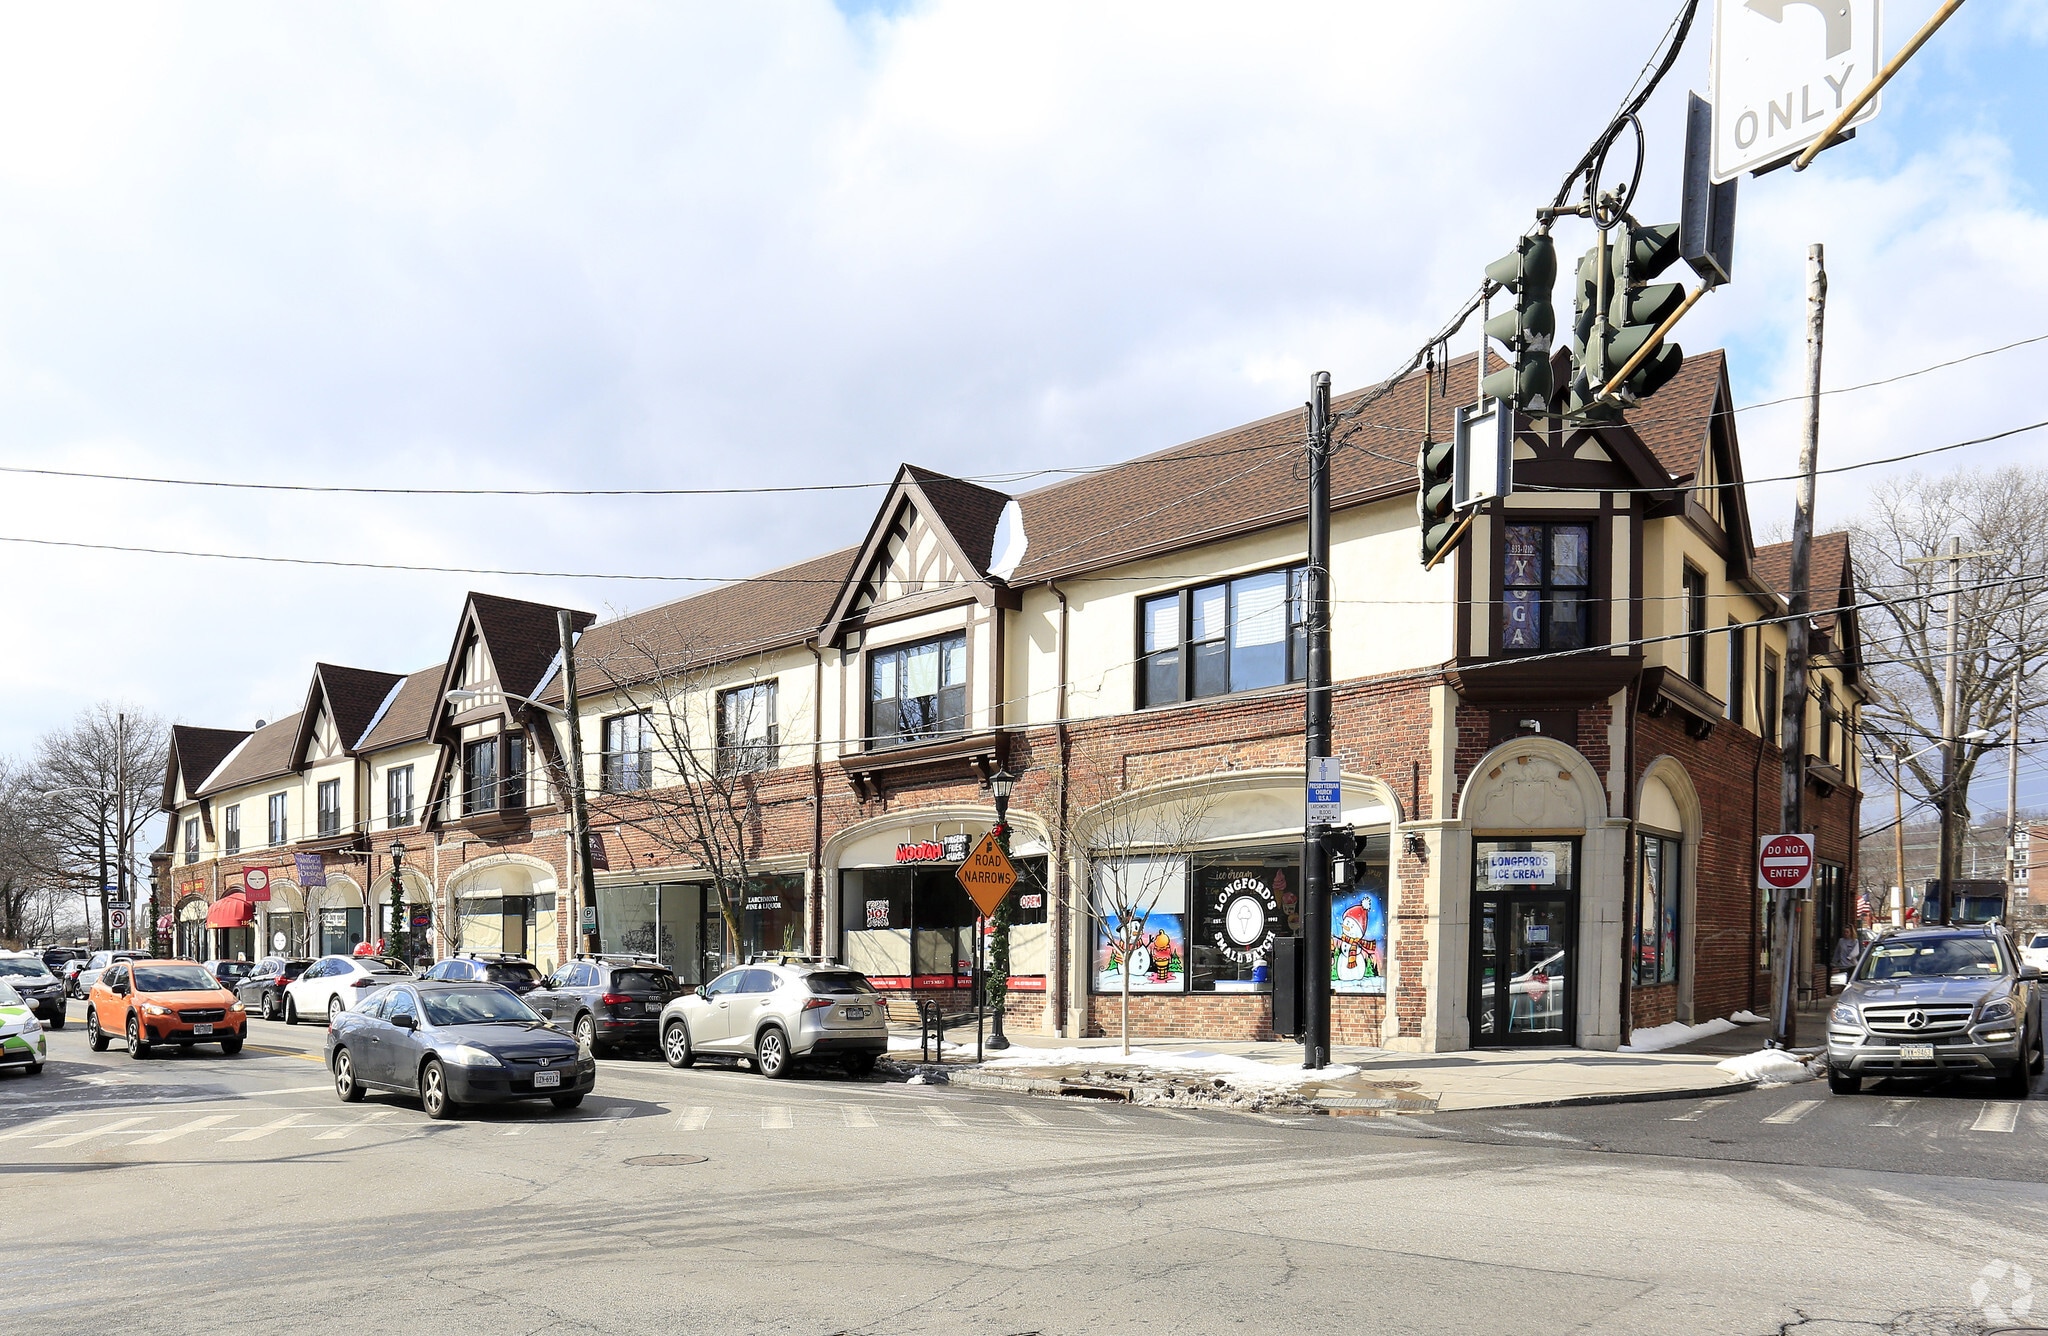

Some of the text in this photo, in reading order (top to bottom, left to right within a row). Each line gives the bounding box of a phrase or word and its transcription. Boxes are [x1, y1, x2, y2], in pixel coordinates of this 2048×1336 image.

[1734, 63, 1855, 150] ONLY
[1511, 560, 1528, 645] YOGA
[896, 841, 943, 863] MOOYAH
[1767, 845, 1805, 855] DO NOT
[975, 854, 1001, 867] ROAD
[964, 871, 1011, 884] NARROWS
[1495, 869, 1545, 879] ICE CREAM
[1770, 869, 1799, 877] ENTER
[747, 895, 779, 903] LARCHMONT
[1021, 894, 1041, 908] OPEN
[1214, 878, 1277, 912] LONGFORD'S
[762, 902, 782, 910] LIQUOR
[1214, 930, 1276, 963] SMALL BATCH
